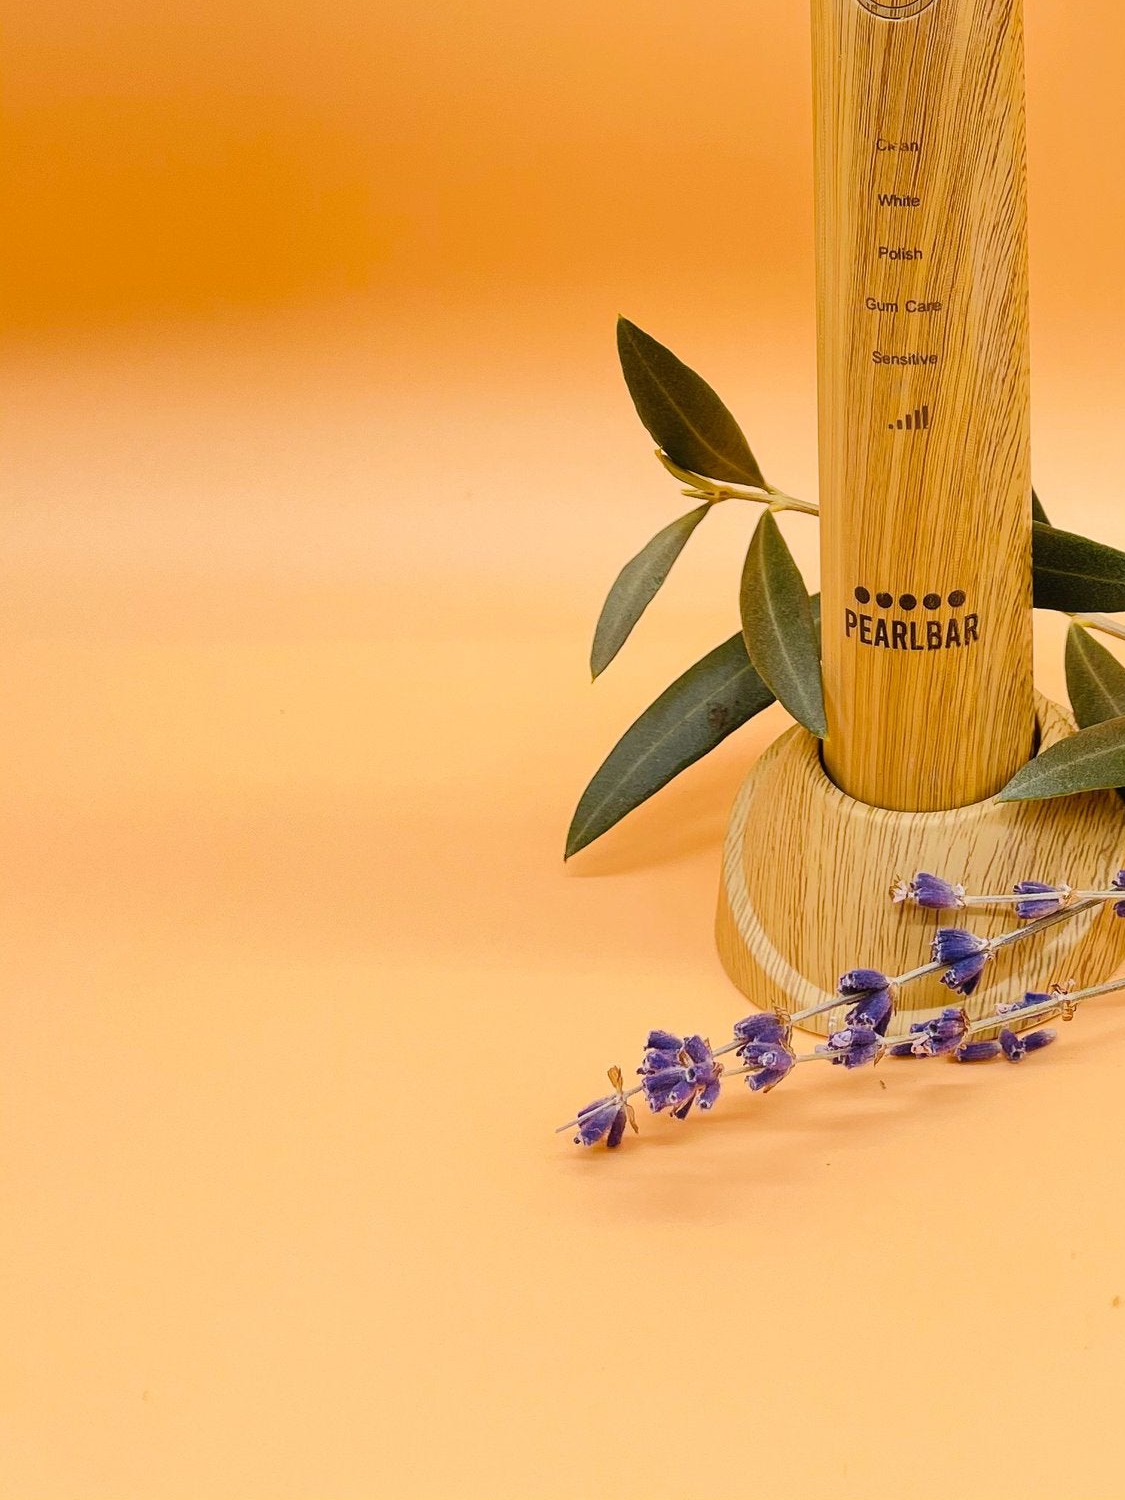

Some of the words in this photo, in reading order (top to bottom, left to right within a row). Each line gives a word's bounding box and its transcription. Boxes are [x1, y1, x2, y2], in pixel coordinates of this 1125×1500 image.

[877, 194, 921, 207] White
[878, 246, 923, 260] Polish
[865, 297, 899, 313] Gum
[905, 298, 942, 313] Care
[872, 350, 938, 366] Sensitive
[845, 607, 979, 651] PEARLBAR
